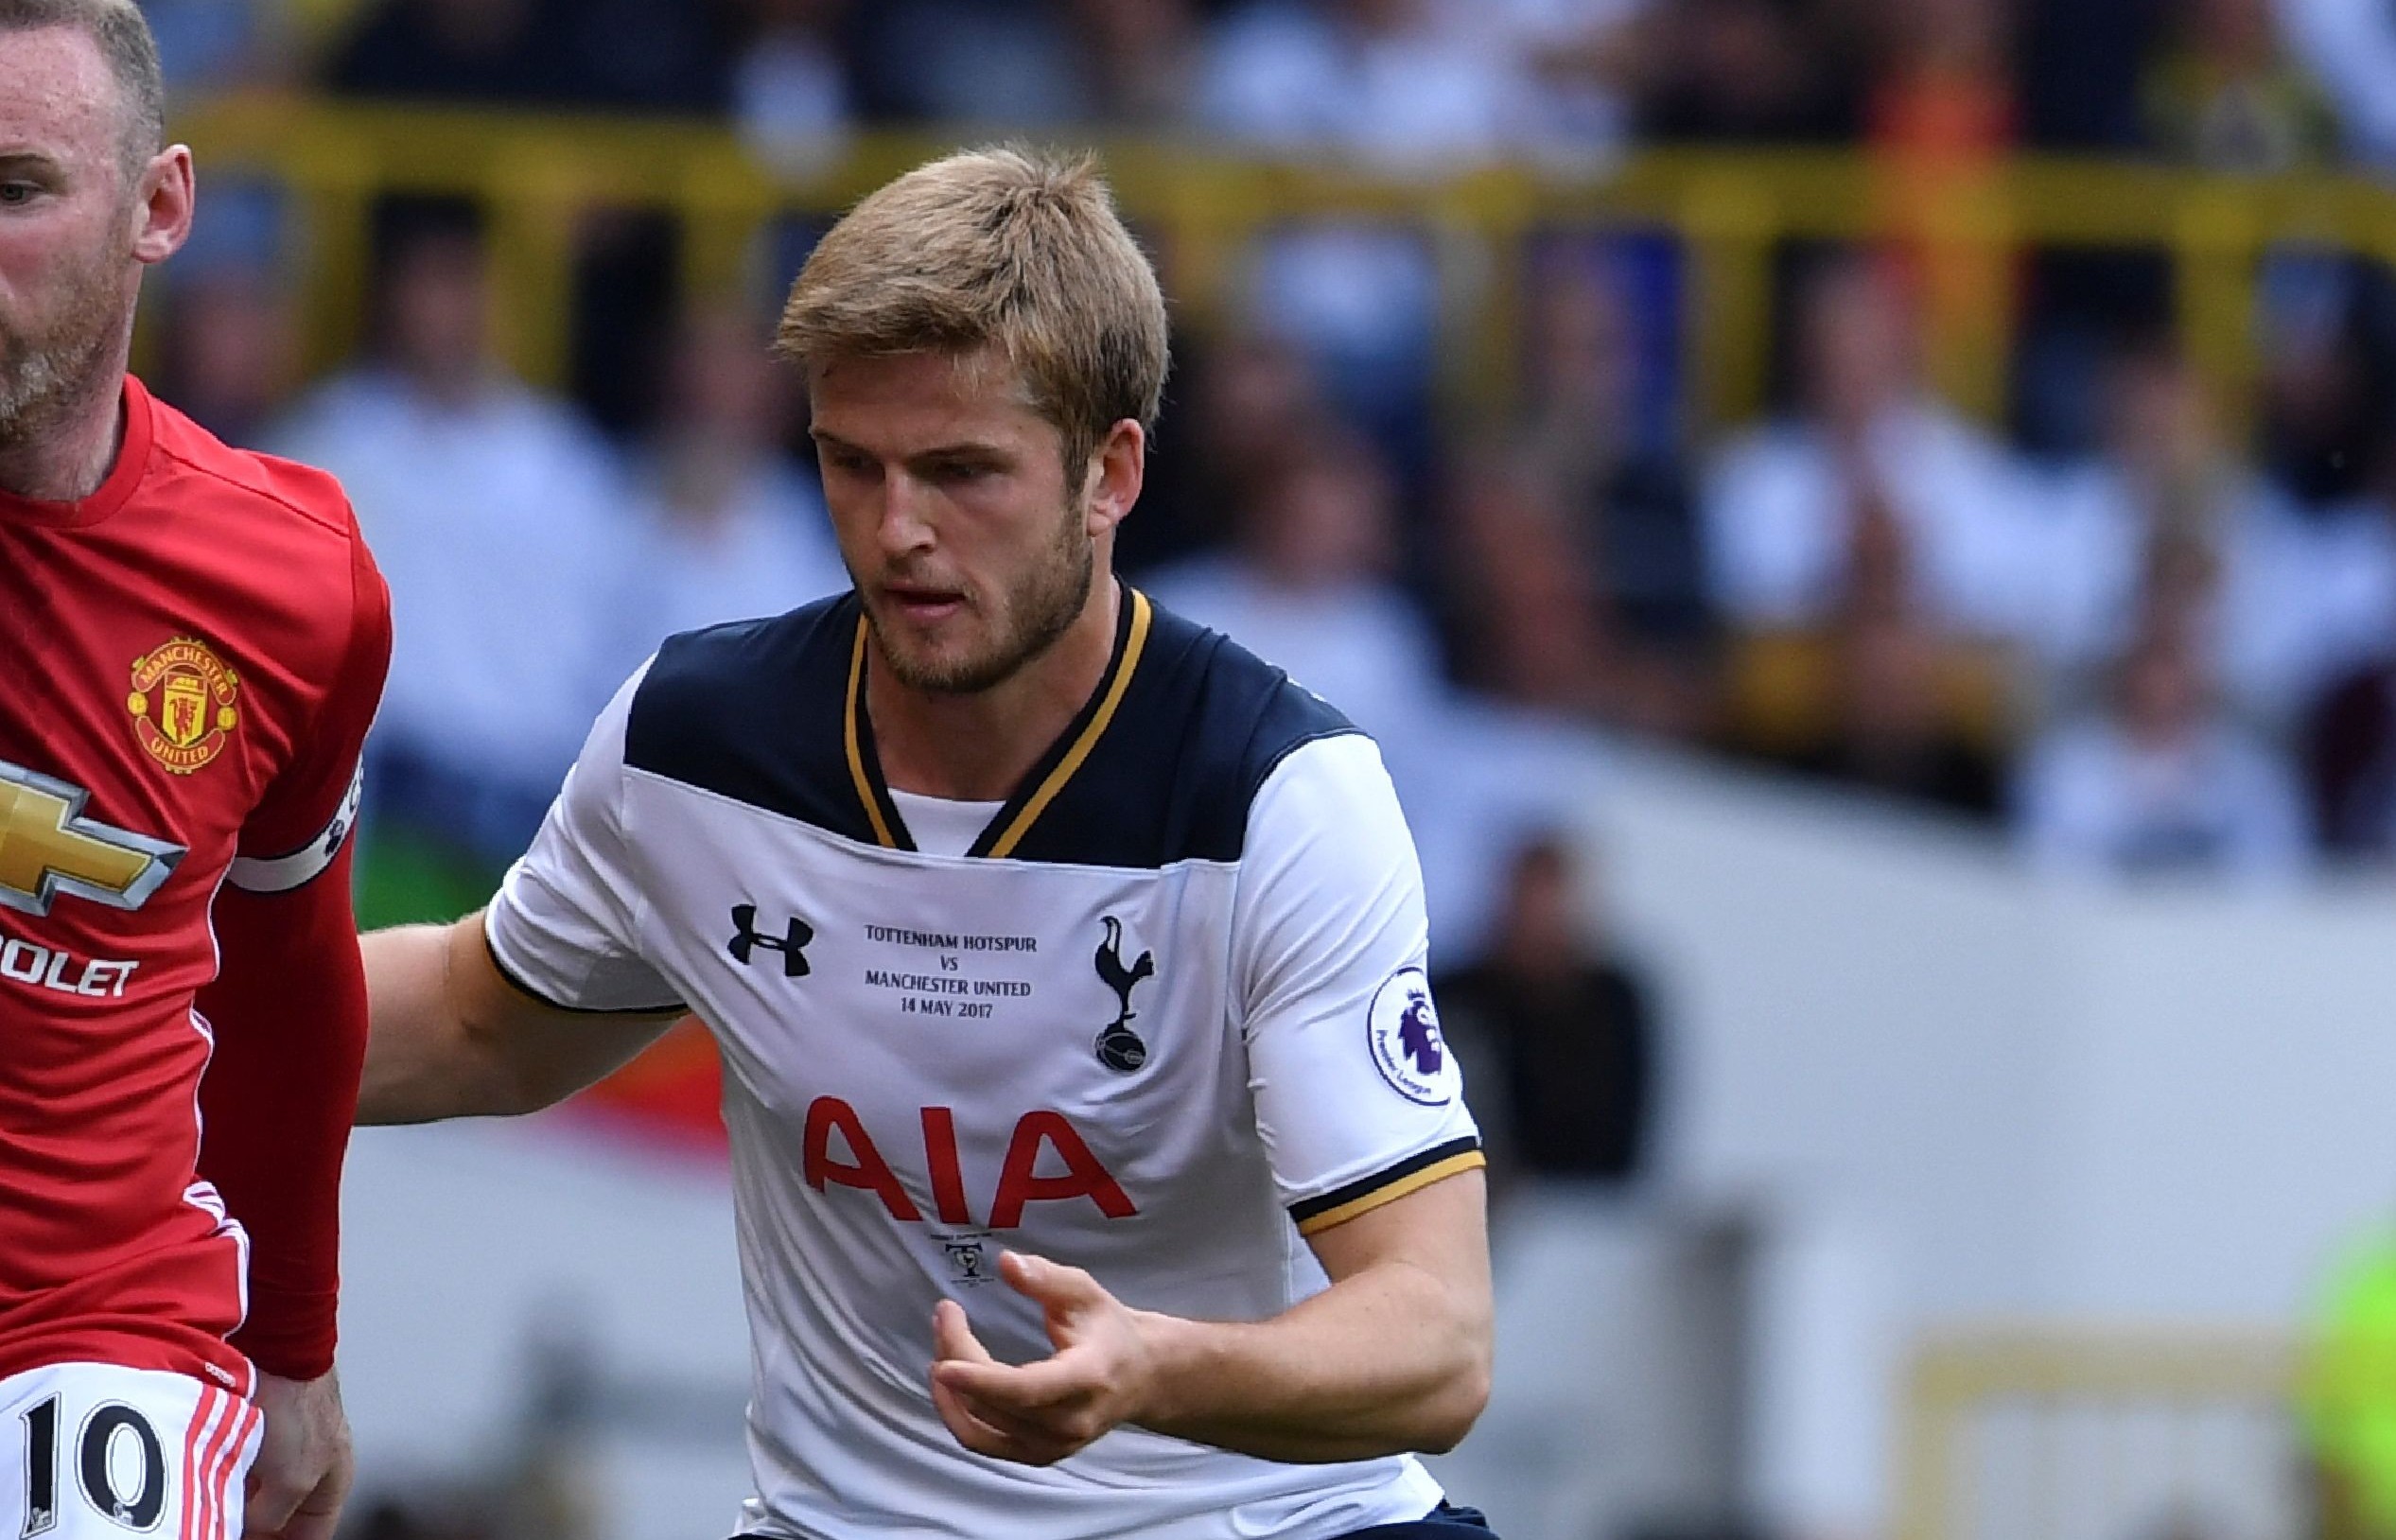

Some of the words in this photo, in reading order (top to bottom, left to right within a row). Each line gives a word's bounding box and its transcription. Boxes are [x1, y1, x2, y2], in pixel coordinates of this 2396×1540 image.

[140, 646, 228, 695] MANCHESTER
[151, 737, 209, 764] UNITED
[865, 924, 958, 949] TOTTENHAM
[963, 936, 1038, 953] HOTSPUR
[0, 934, 140, 997] OLET
[940, 954, 959, 971] VS
[865, 970, 969, 995] MANCHESTER
[973, 981, 1032, 997] UNITED
[901, 997, 916, 1013] 14
[920, 999, 953, 1017] MAY
[958, 1003, 993, 1019] 2017
[803, 1094, 1139, 1229] AIA
[18, 1391, 169, 1538] 10
